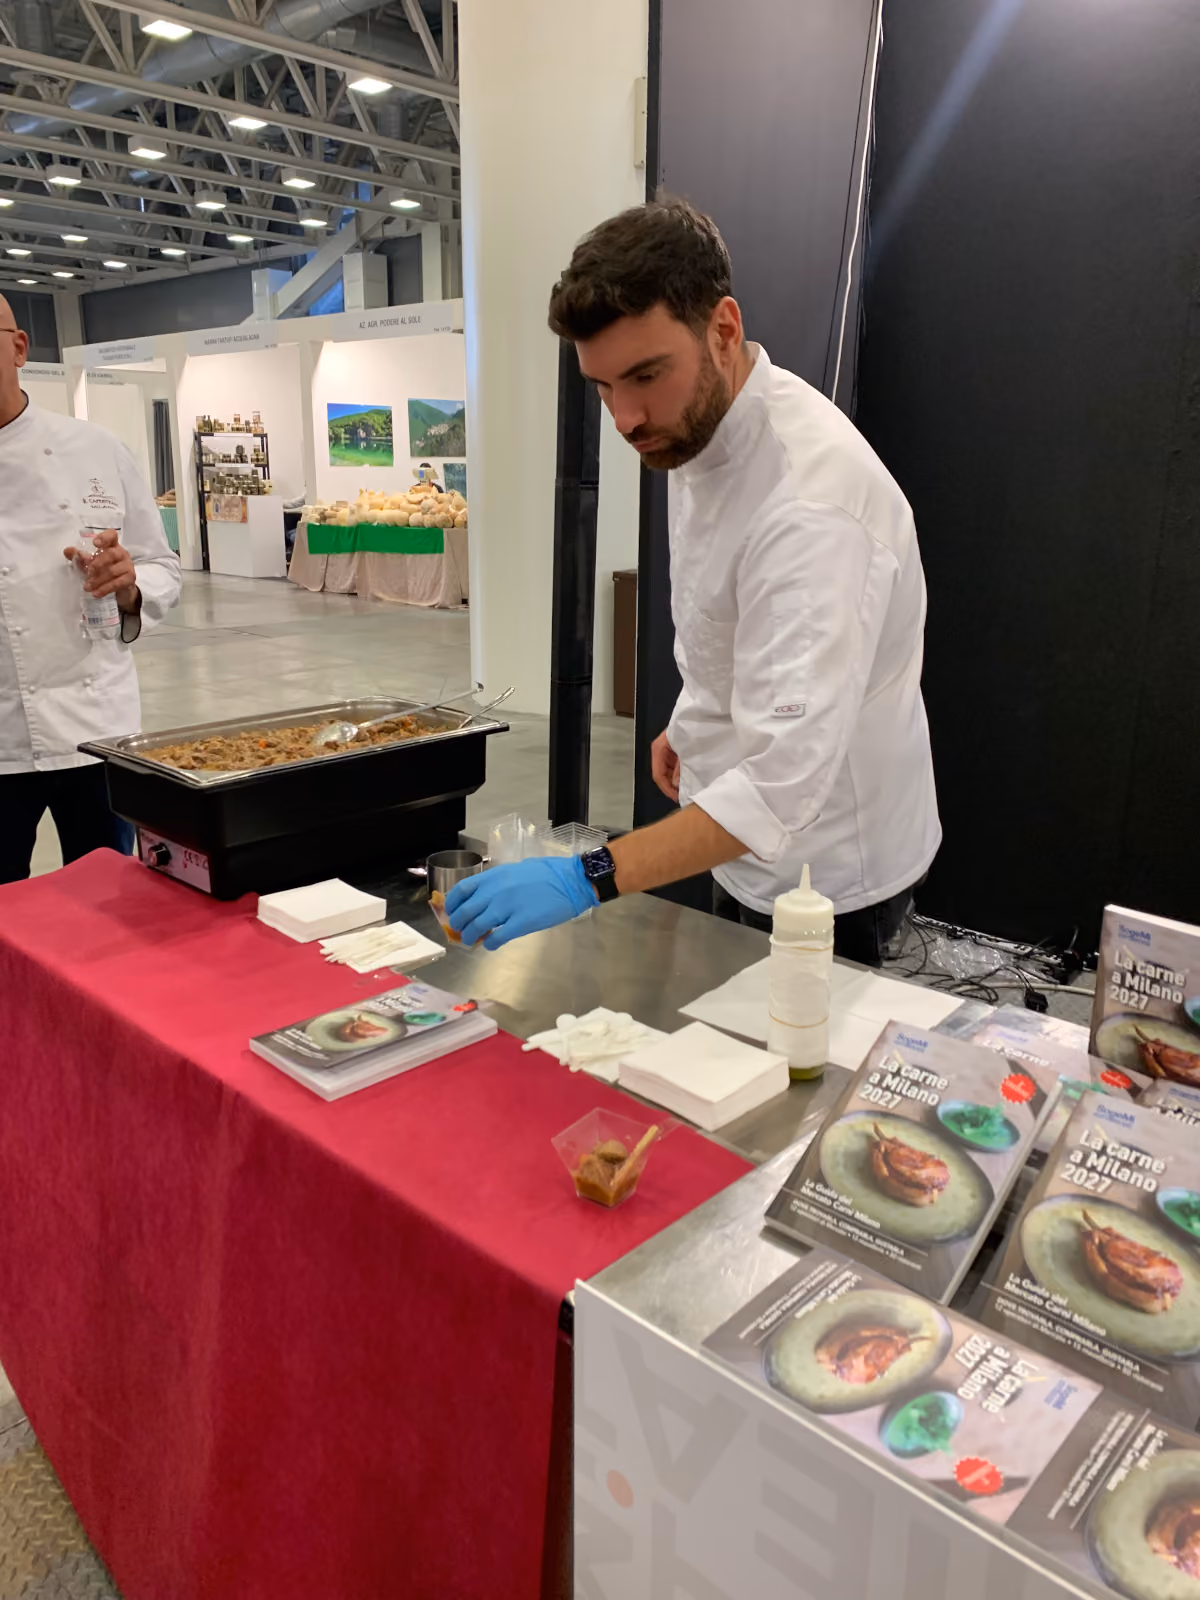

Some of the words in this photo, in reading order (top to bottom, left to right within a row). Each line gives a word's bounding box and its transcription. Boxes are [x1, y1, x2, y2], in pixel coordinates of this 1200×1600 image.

[380, 318, 400, 327] PODERE
[400, 317, 408, 325] AL
[408, 315, 422, 325] SOLE
[1114, 949, 1134, 971] La
[1135, 958, 1186, 987] carne
[1110, 984, 1149, 1010] 2027
[1111, 971, 1122, 985] a
[1124, 971, 1184, 1004] Milano
[869, 1072, 882, 1086] a
[882, 1072, 940, 1107] Milano
[878, 1054, 900, 1074] La
[900, 1063, 949, 1091] carne
[859, 1083, 903, 1110] 2027
[1080, 1129, 1104, 1151] La
[1106, 1141, 1166, 1174] carne
[1060, 1163, 1112, 1193] 2027
[1069, 1149, 1083, 1164] a
[1085, 1150, 1158, 1193] Milano
[1009, 1272, 1019, 1284] La
[1004, 1281, 1044, 1306] Mercato
[1045, 1299, 1072, 1318] Carni
[954, 1334, 992, 1369] 2027
[993, 1346, 1011, 1360] a
[1011, 1359, 1040, 1378] La
[957, 1354, 1009, 1400] Milano
[981, 1373, 1023, 1414] carne
